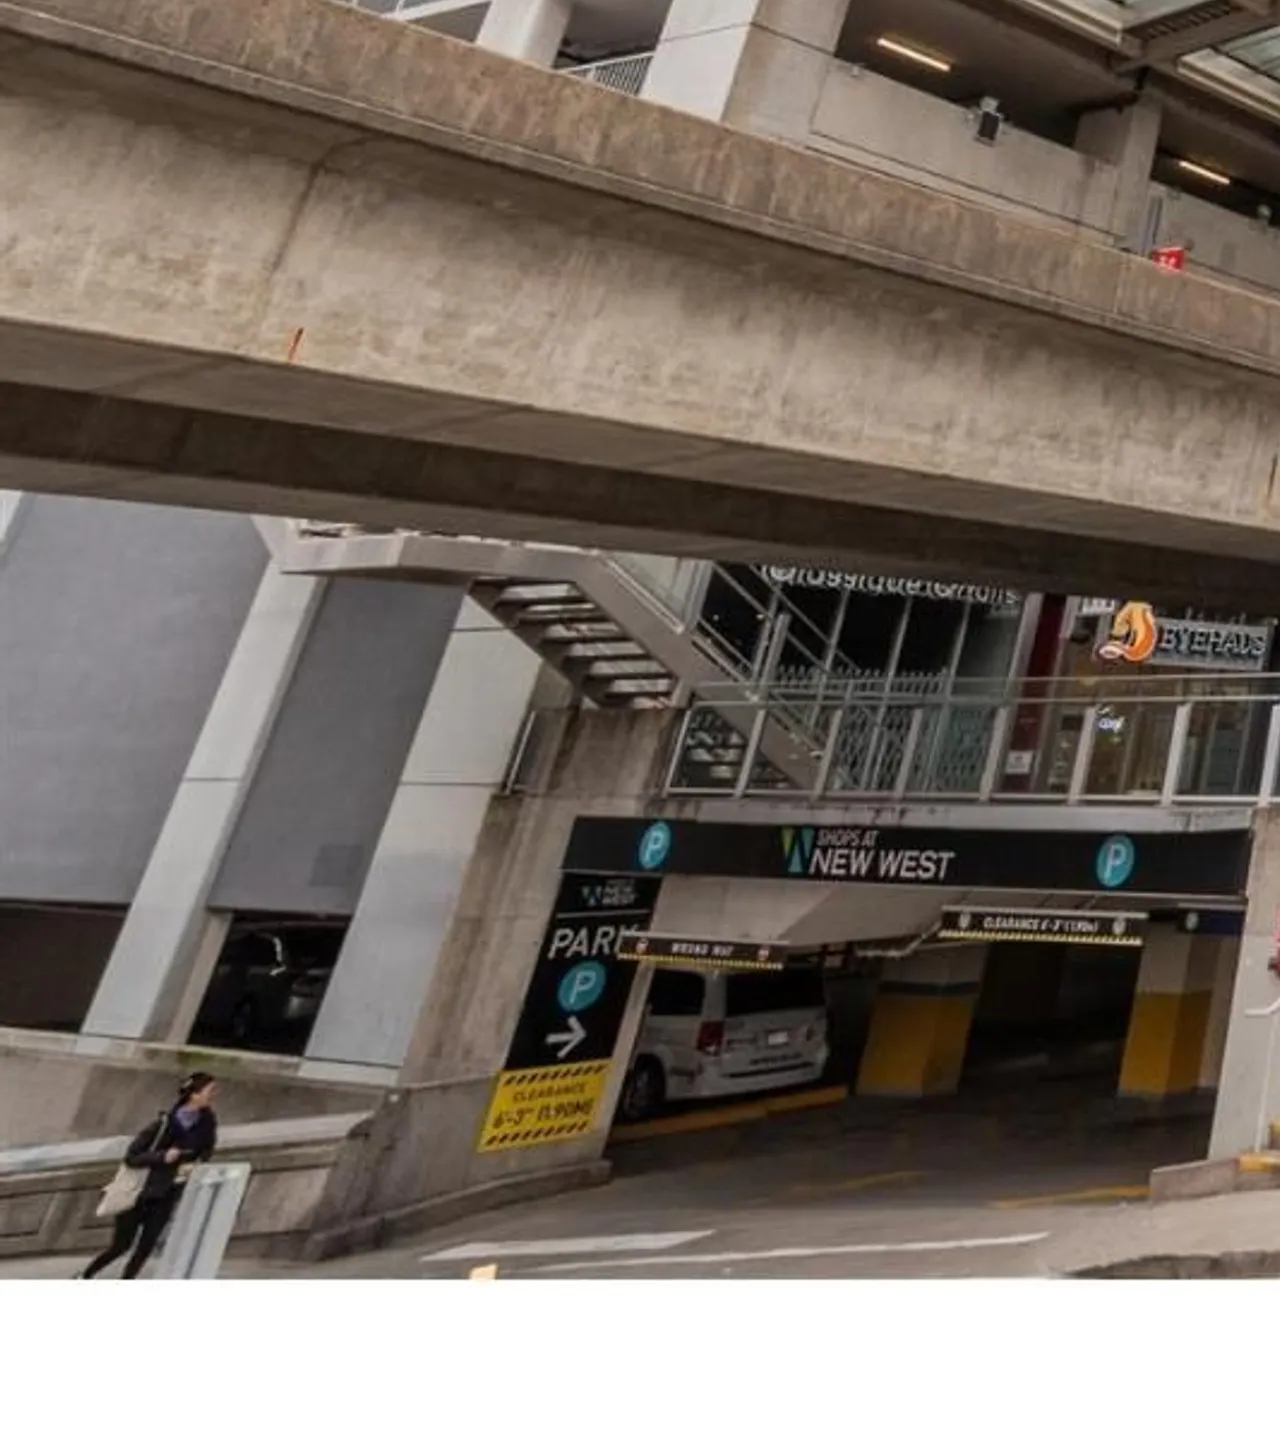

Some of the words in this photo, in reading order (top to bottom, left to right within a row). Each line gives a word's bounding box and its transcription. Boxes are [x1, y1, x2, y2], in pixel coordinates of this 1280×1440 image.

[816, 828, 861, 847] SHOPS
[862, 829, 880, 848] AT
[808, 849, 875, 877] NEW
[878, 849, 957, 880] WEST
[513, 1082, 586, 1103] CLEARANCE
